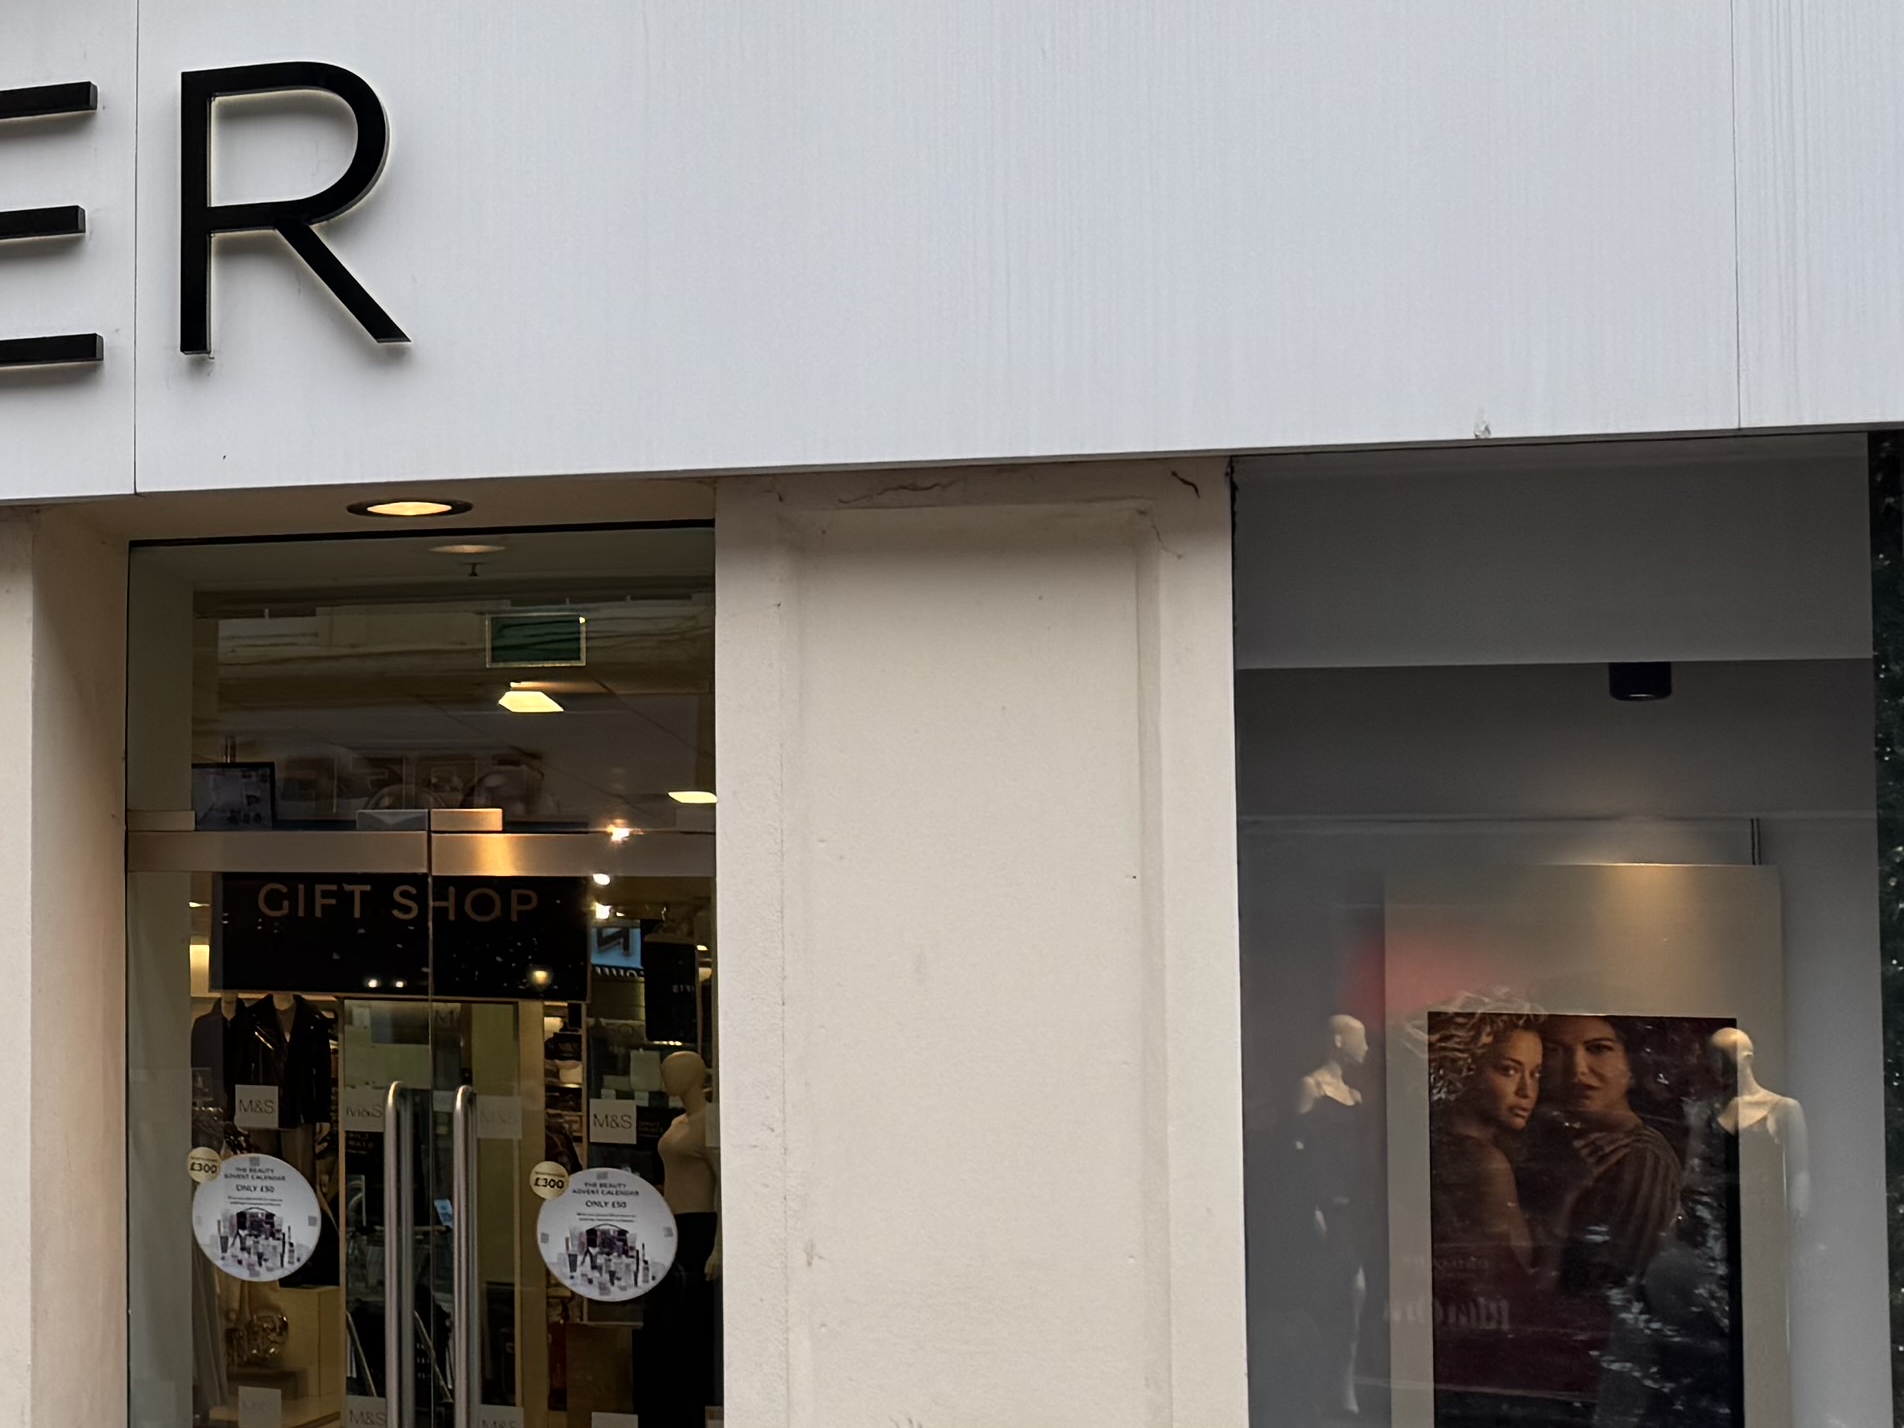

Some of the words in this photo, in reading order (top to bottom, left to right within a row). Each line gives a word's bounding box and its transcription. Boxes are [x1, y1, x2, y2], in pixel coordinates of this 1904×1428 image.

[258, 883, 371, 918] GIFT
[392, 885, 538, 922] SHOP
[239, 1099, 276, 1115] M&S
[593, 1114, 633, 1130] M&S
[190, 1162, 218, 1174] £300
[251, 1174, 287, 1182] CALENDAR
[534, 1177, 565, 1190] £300
[235, 1184, 257, 1193] ONLY
[601, 1189, 640, 1197] CALENDAR
[585, 1200, 610, 1209] ONLY
[348, 1408, 386, 1427] M&S
